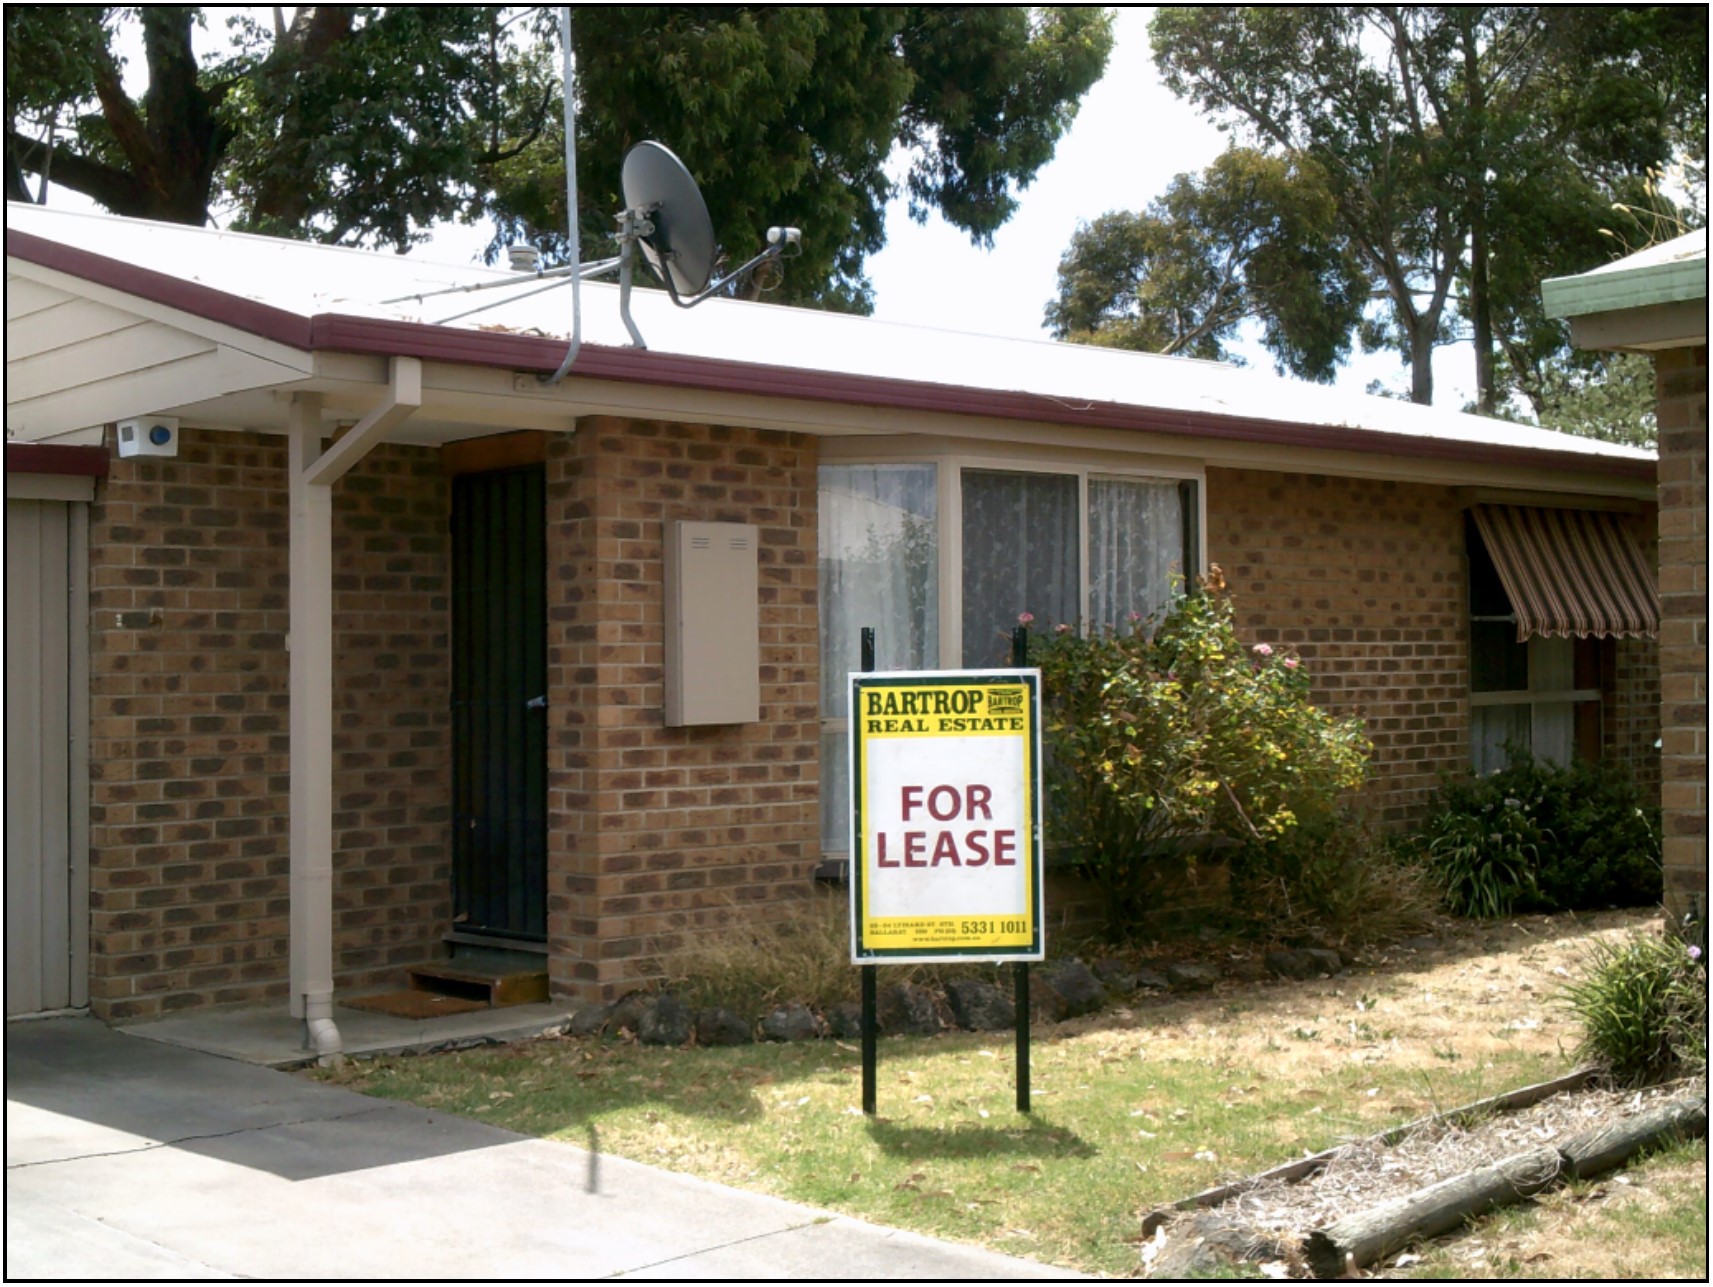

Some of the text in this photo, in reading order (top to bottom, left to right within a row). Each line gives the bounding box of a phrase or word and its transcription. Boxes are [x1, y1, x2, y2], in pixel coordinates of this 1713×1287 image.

[867, 690, 984, 716] BARTROP
[988, 694, 1024, 708] BARTROP
[867, 717, 1024, 733] REAL ESTATE
[901, 784, 993, 822] FOR
[877, 830, 1016, 868] LEASE
[961, 921, 995, 934] 5331
[1000, 920, 1027, 934] 1011
